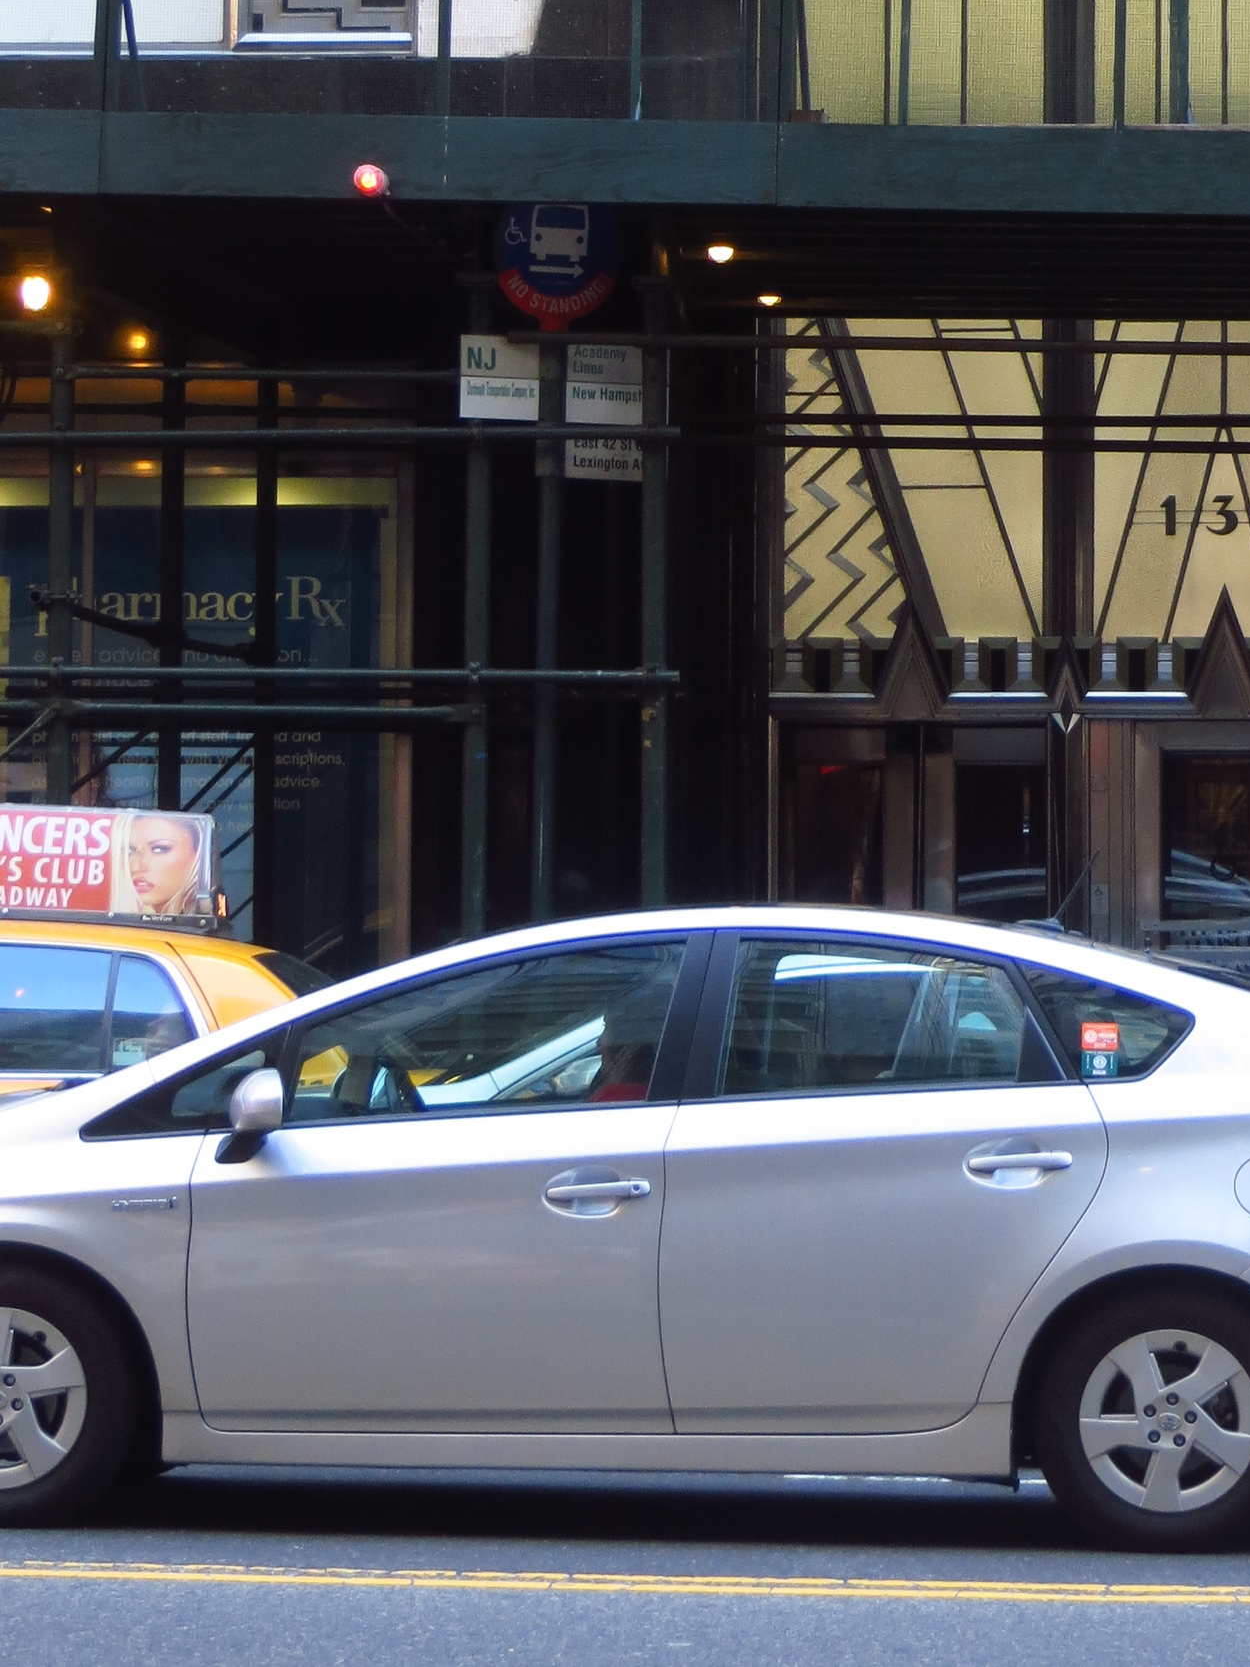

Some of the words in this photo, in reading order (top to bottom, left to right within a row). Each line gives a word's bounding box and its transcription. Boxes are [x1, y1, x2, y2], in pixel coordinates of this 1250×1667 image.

[506, 274, 529, 299] NO
[529, 279, 607, 314] STANDING
[466, 346, 497, 371] NJ
[574, 345, 627, 363] Academy
[572, 360, 604, 375] Lines
[572, 386, 597, 401] New
[600, 387, 642, 404] Hampsh
[602, 439, 616, 450] 42
[573, 454, 628, 472] Lexington
[252, 752, 346, 768] scriptions,
[0, 814, 112, 856] NCERS
[34, 857, 105, 886] CLUB
